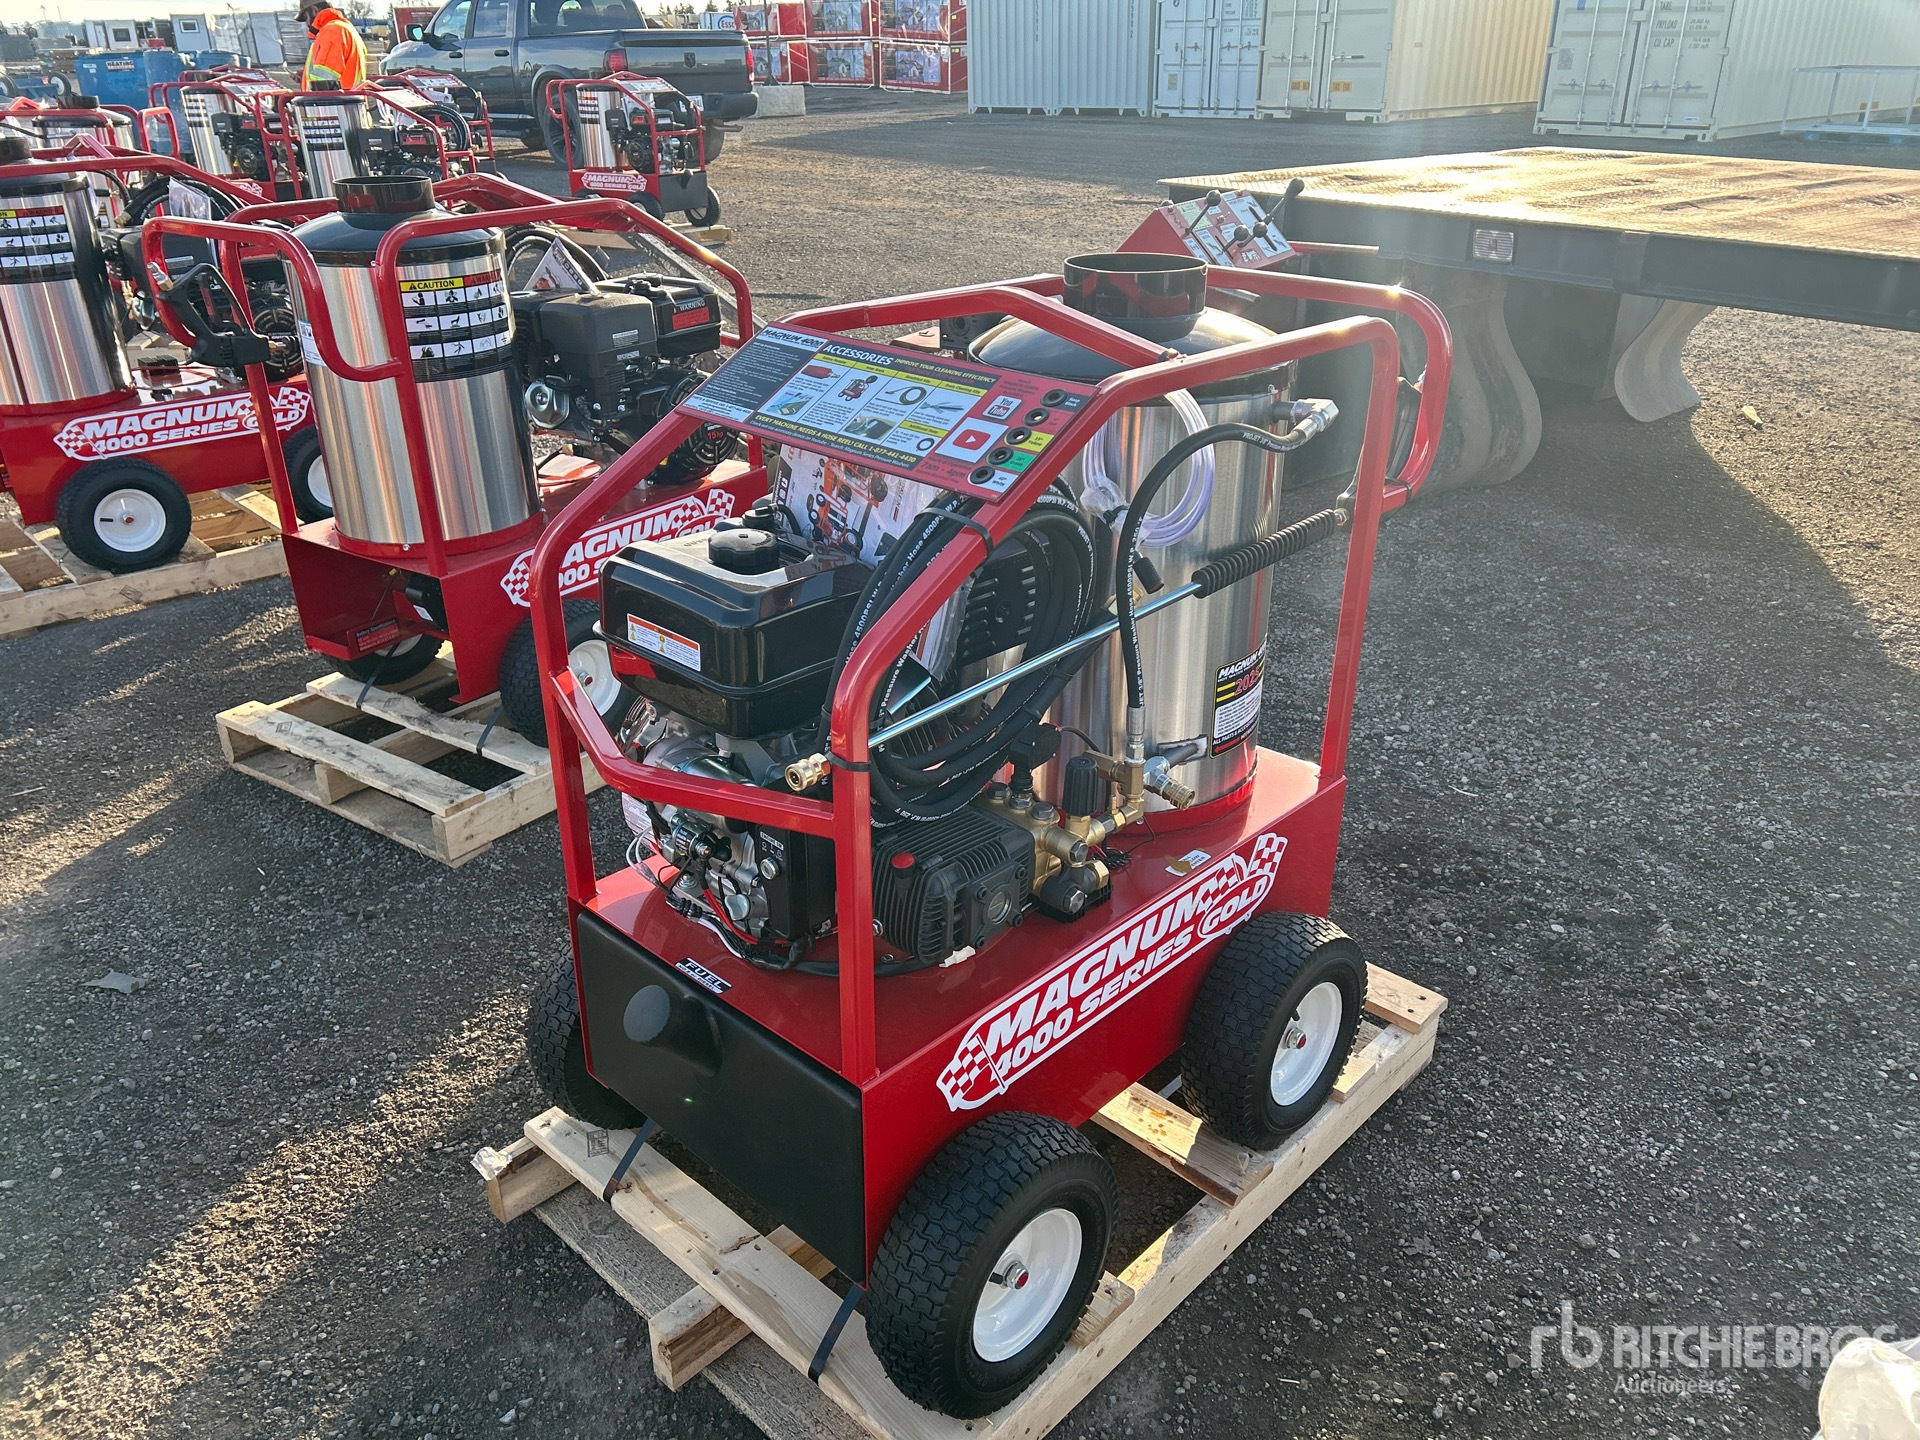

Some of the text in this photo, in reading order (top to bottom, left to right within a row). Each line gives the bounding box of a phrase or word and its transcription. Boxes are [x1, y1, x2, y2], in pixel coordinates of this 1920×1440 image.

[1656, 20, 1677, 29] PAYLOAD
[587, 173, 629, 184] MAGNUM
[417, 280, 455, 290] CAUTION
[680, 300, 706, 312] WARNING
[762, 328, 801, 342] MAGNUM
[822, 344, 894, 366] ACCESSORIES
[895, 358, 919, 368] IMPROVE
[919, 363, 934, 371] YOUR
[934, 366, 962, 377] CLEANING
[962, 372, 997, 384] EFFICIENCY
[989, 405, 1008, 416] Tube
[1000, 397, 1014, 407] You
[83, 400, 247, 440] MAGNUM
[93, 433, 148, 452] 4000
[152, 418, 238, 443] SERIES
[755, 414, 773, 424] EVERY
[772, 418, 799, 431] MACHINE
[799, 425, 817, 436] NEEDS
[821, 433, 837, 441] HOSE
[836, 436, 854, 446] REEL!
[854, 441, 869, 450] CALL
[868, 446, 917, 463] 1-877-441-4430
[1242, 432, 1261, 442] PROJET
[844, 445, 863, 454] Magnum
[875, 453, 893, 463] Pressure
[893, 458, 909, 467] Washers
[921, 461, 940, 472] 7am
[947, 467, 966, 479] 4pm
[561, 508, 684, 568] AGNUM
[906, 540, 924, 562] Hose
[921, 514, 945, 540] 4500PS
[1126, 564, 1134, 598] 4500PSI
[854, 598, 874, 639] 4500PSI
[1128, 599, 1136, 618] Hose
[1130, 617, 1140, 645] Washer
[881, 634, 919, 708] Pressure Washer
[1134, 648, 1143, 676] Pressure
[1218, 654, 1258, 679] MAGNUM
[1221, 733, 1234, 742] PARTS
[685, 961, 722, 989] FUEL
[984, 874, 1212, 1053] MAGNUM
[697, 978, 715, 990] DIESEL
[991, 877, 1266, 1082] 4000 SERIES GOLD
